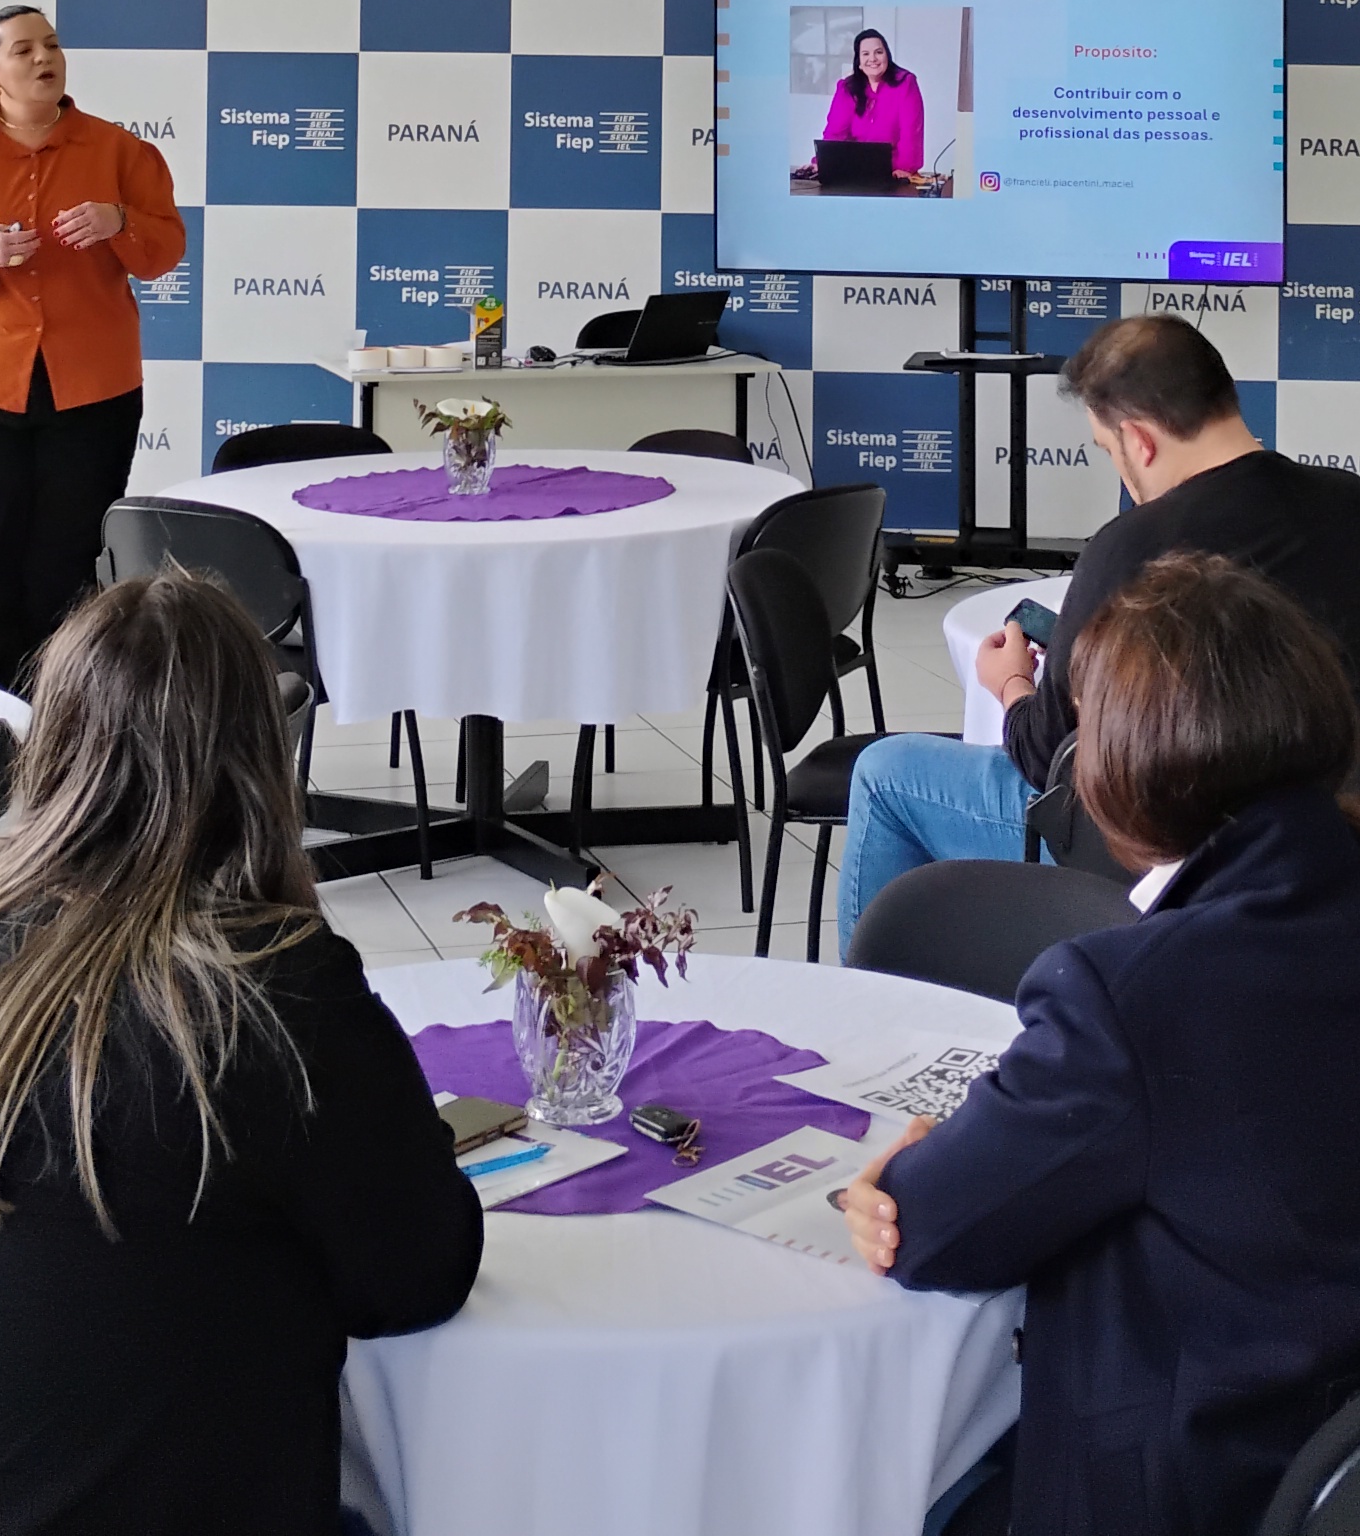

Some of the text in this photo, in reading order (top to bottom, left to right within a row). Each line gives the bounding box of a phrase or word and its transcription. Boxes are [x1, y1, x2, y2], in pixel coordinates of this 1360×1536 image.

[1074, 45, 1158, 60] Propósito:
[1054, 87, 1181, 100] Contribuir com o
[221, 109, 289, 124] Sistema
[525, 112, 593, 127] Sistema
[1012, 107, 1220, 123] desenvolvimento pessoal e
[389, 120, 479, 142] PARANÁ
[1019, 127, 1213, 142] profissional das pessoas.
[253, 130, 289, 149] Fiep
[557, 133, 593, 152] Fiep
[1223, 252, 1252, 267] IEL
[370, 266, 439, 281] Sistema
[675, 271, 744, 287] Sistema
[235, 274, 325, 296] PARANÁ
[539, 278, 629, 300] PARANÁ
[1283, 282, 1353, 298] Sistema
[402, 287, 439, 306] Fiep
[844, 282, 936, 305] PARANÁ
[1152, 289, 1246, 312] PARANÁ
[1316, 304, 1354, 323] Fiep
[827, 430, 896, 446] Sistema
[859, 451, 896, 471] Fiep
